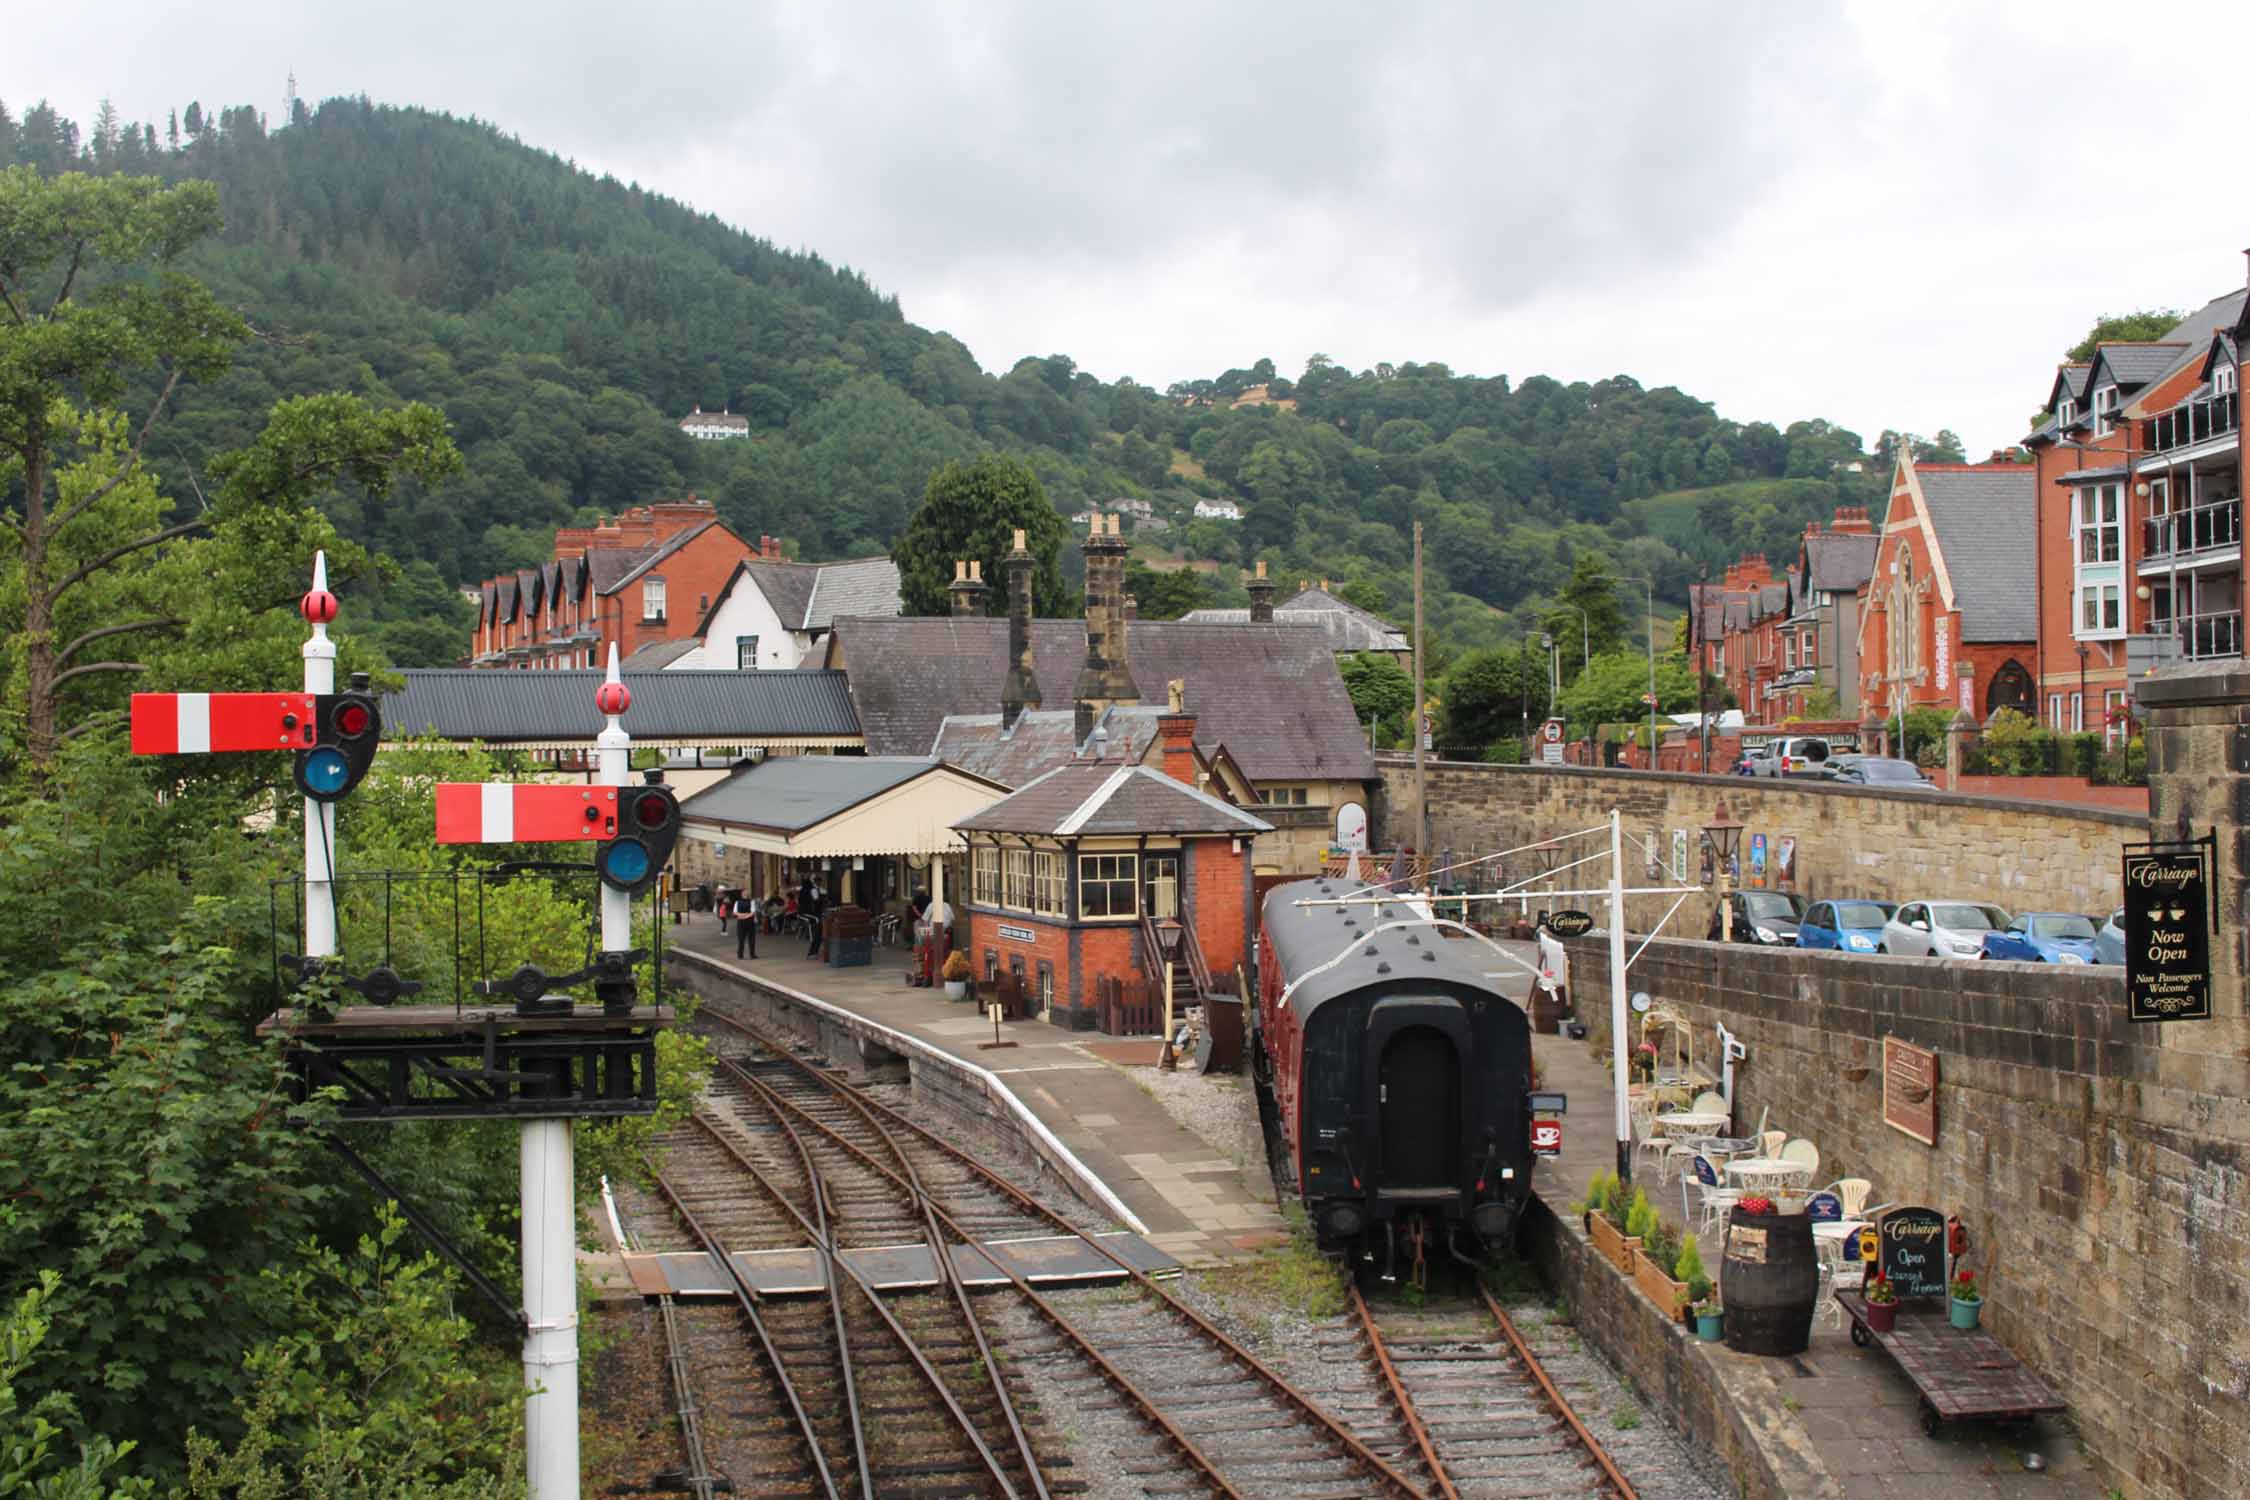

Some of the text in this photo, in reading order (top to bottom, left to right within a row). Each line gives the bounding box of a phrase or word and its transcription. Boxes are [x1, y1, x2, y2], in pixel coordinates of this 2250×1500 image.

[2131, 861, 2198, 890] Carriage
[2151, 929, 2185, 945] Now
[2148, 946, 2187, 965] Open
[2159, 971, 2203, 984] Passengers
[2149, 983, 2189, 994] Welcome
[1883, 1217, 1942, 1244] Carriage
[1897, 1247, 1926, 1266] Open
